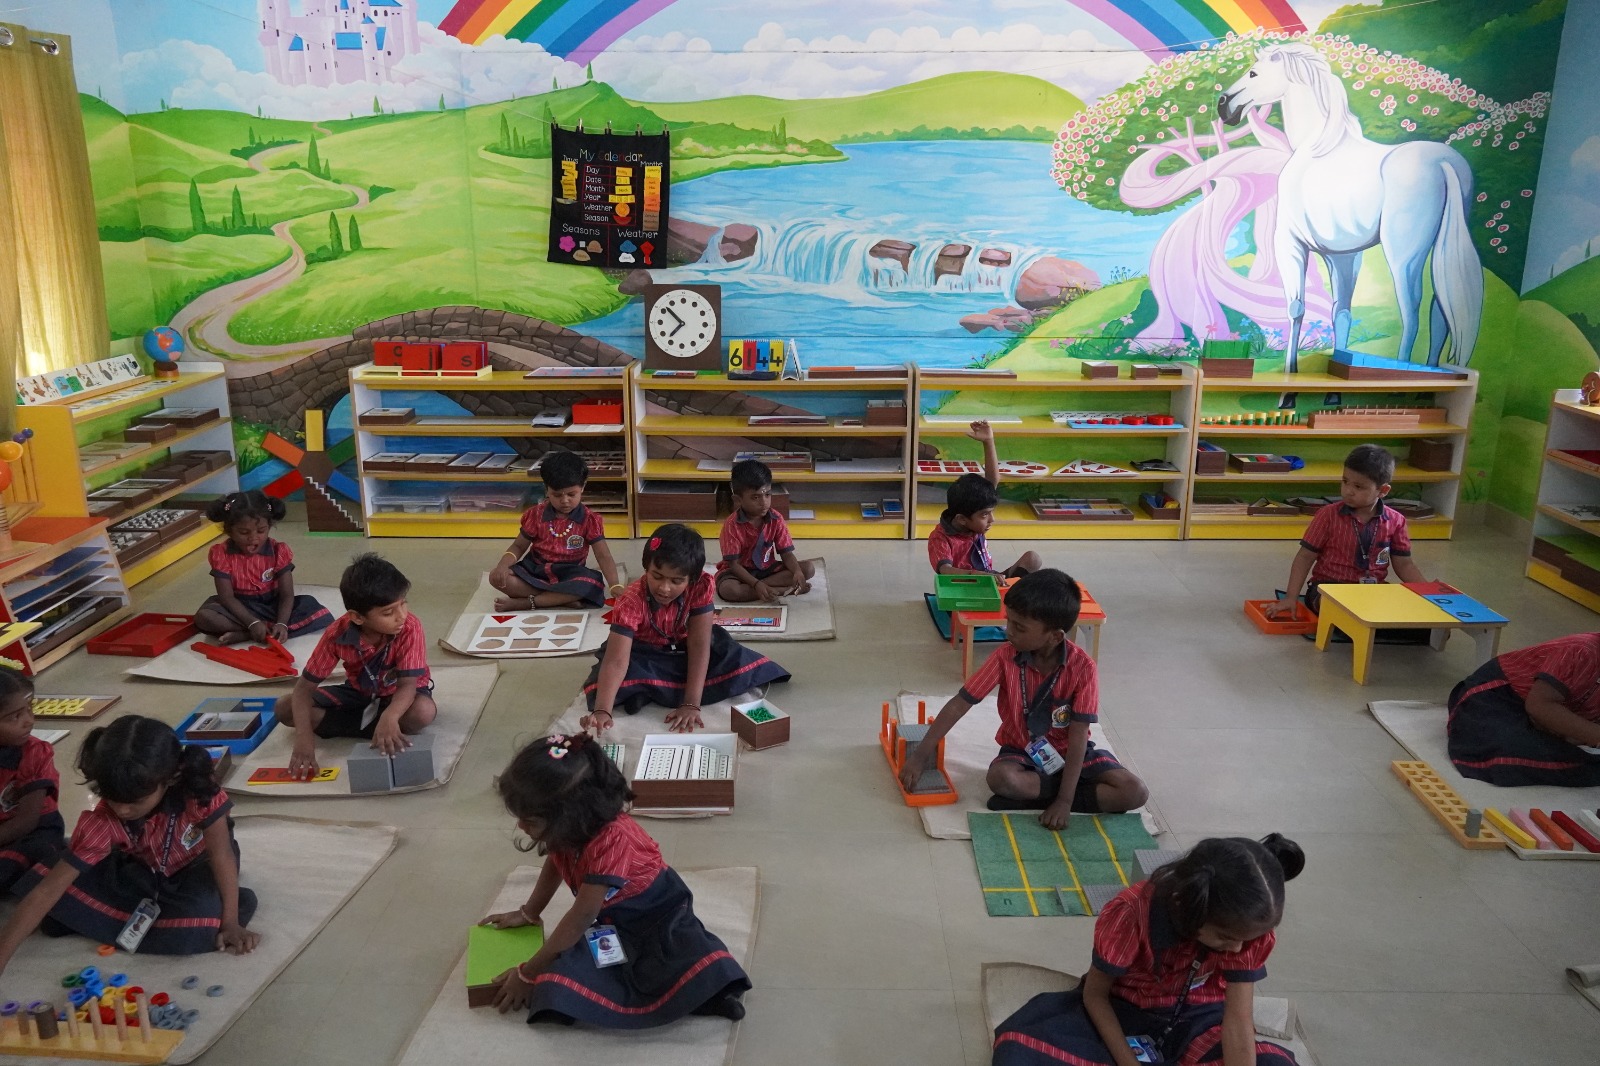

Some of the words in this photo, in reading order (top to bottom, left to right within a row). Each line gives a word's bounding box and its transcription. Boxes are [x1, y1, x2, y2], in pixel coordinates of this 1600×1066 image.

[580, 149, 595, 161] My
[586, 166, 600, 174] Day
[584, 203, 613, 212] Weather
[562, 223, 600, 236] Seasons
[617, 229, 658, 239] Weather
